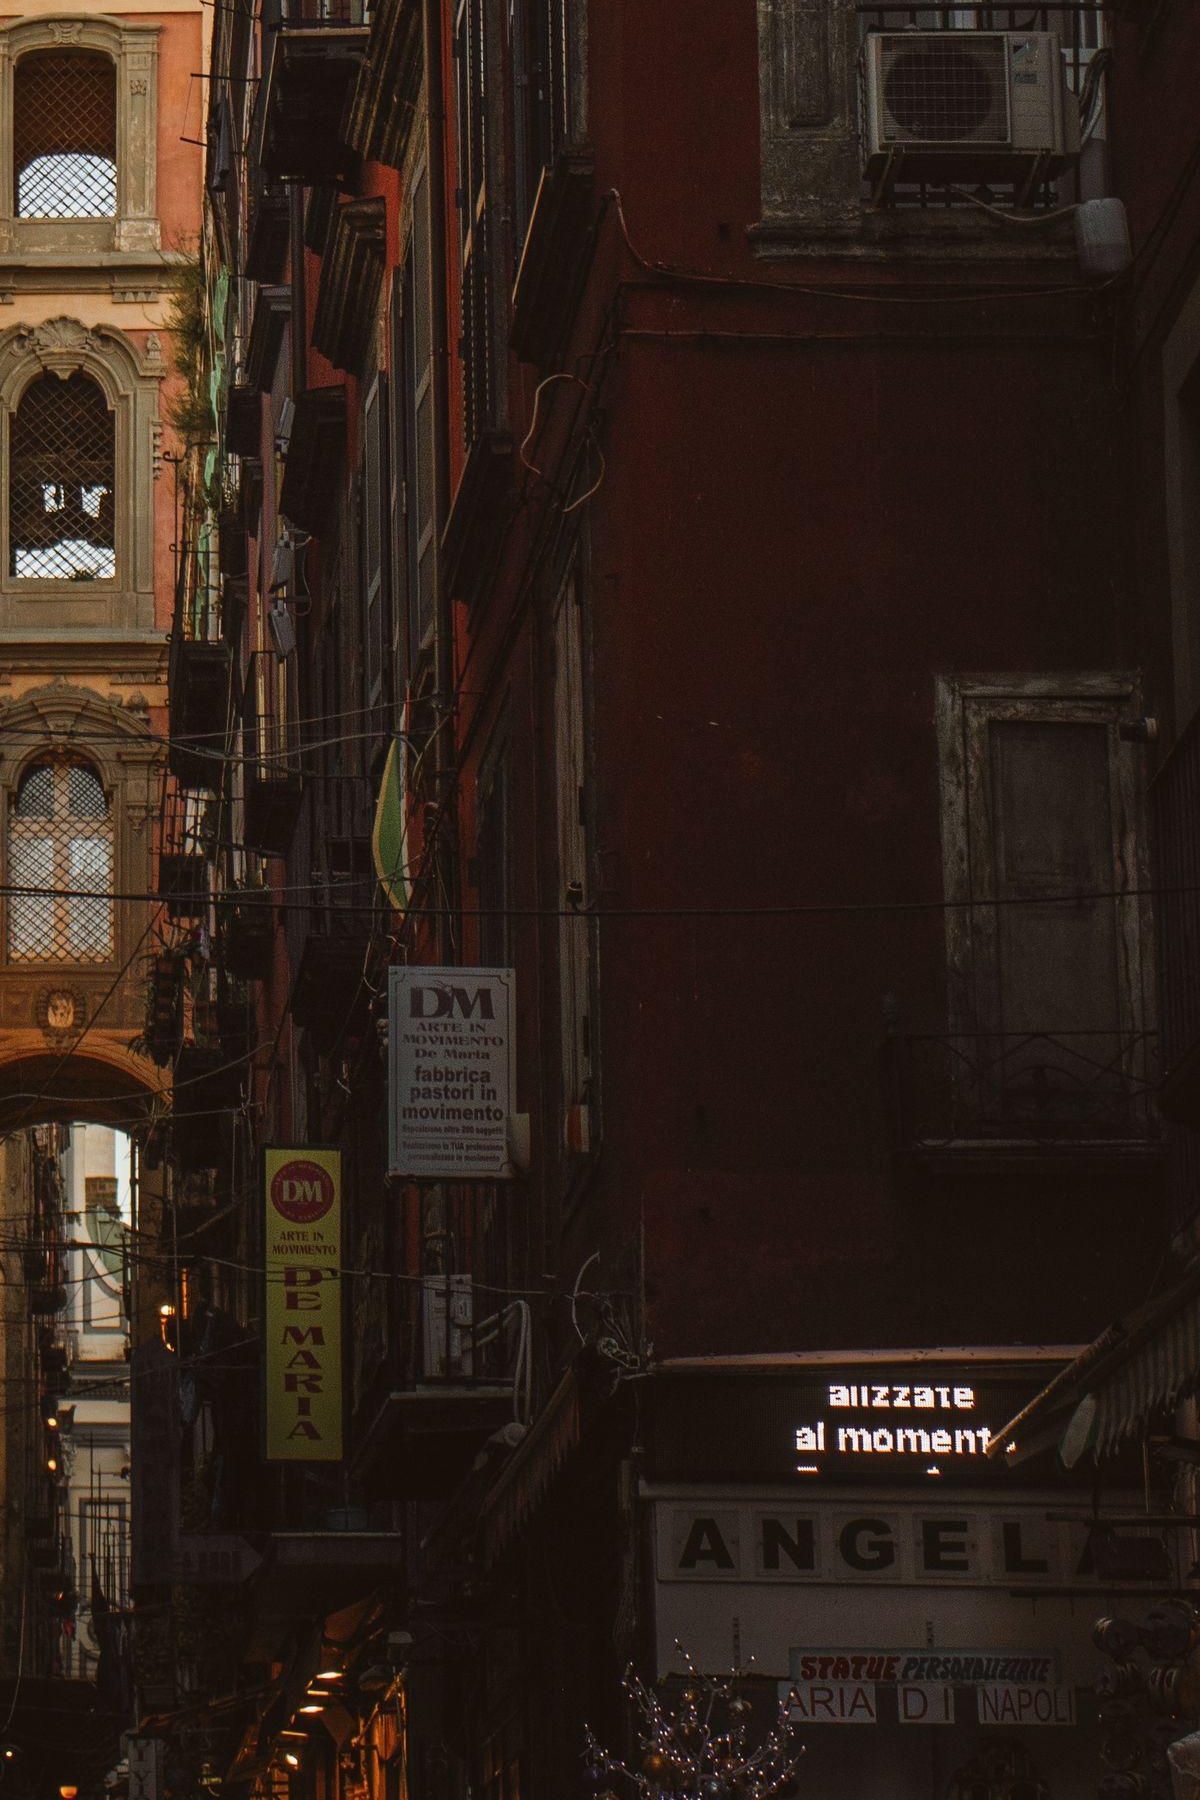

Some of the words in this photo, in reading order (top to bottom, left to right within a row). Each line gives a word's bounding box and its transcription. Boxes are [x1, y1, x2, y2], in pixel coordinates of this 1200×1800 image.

[410, 984, 496, 1020] DM
[417, 1022, 462, 1033] ARTE
[470, 1022, 486, 1033] IN
[402, 1034, 504, 1047] MOVIMENTO
[444, 1048, 490, 1060] Maria
[415, 1065, 491, 1084] fabbrica
[410, 1084, 474, 1103] pastori
[481, 1085, 497, 1101] in
[402, 1103, 504, 1122] movimento
[282, 1178, 323, 1203] DM
[280, 1231, 309, 1241] ARTE
[313, 1231, 324, 1242] IN
[272, 1244, 337, 1256] MOVIMENTO
[795, 1421, 825, 1451] al
[838, 1426, 1016, 1455] moment
[800, 1655, 899, 1680] STATUE
[982, 1688, 1072, 1723] NAPOLI
